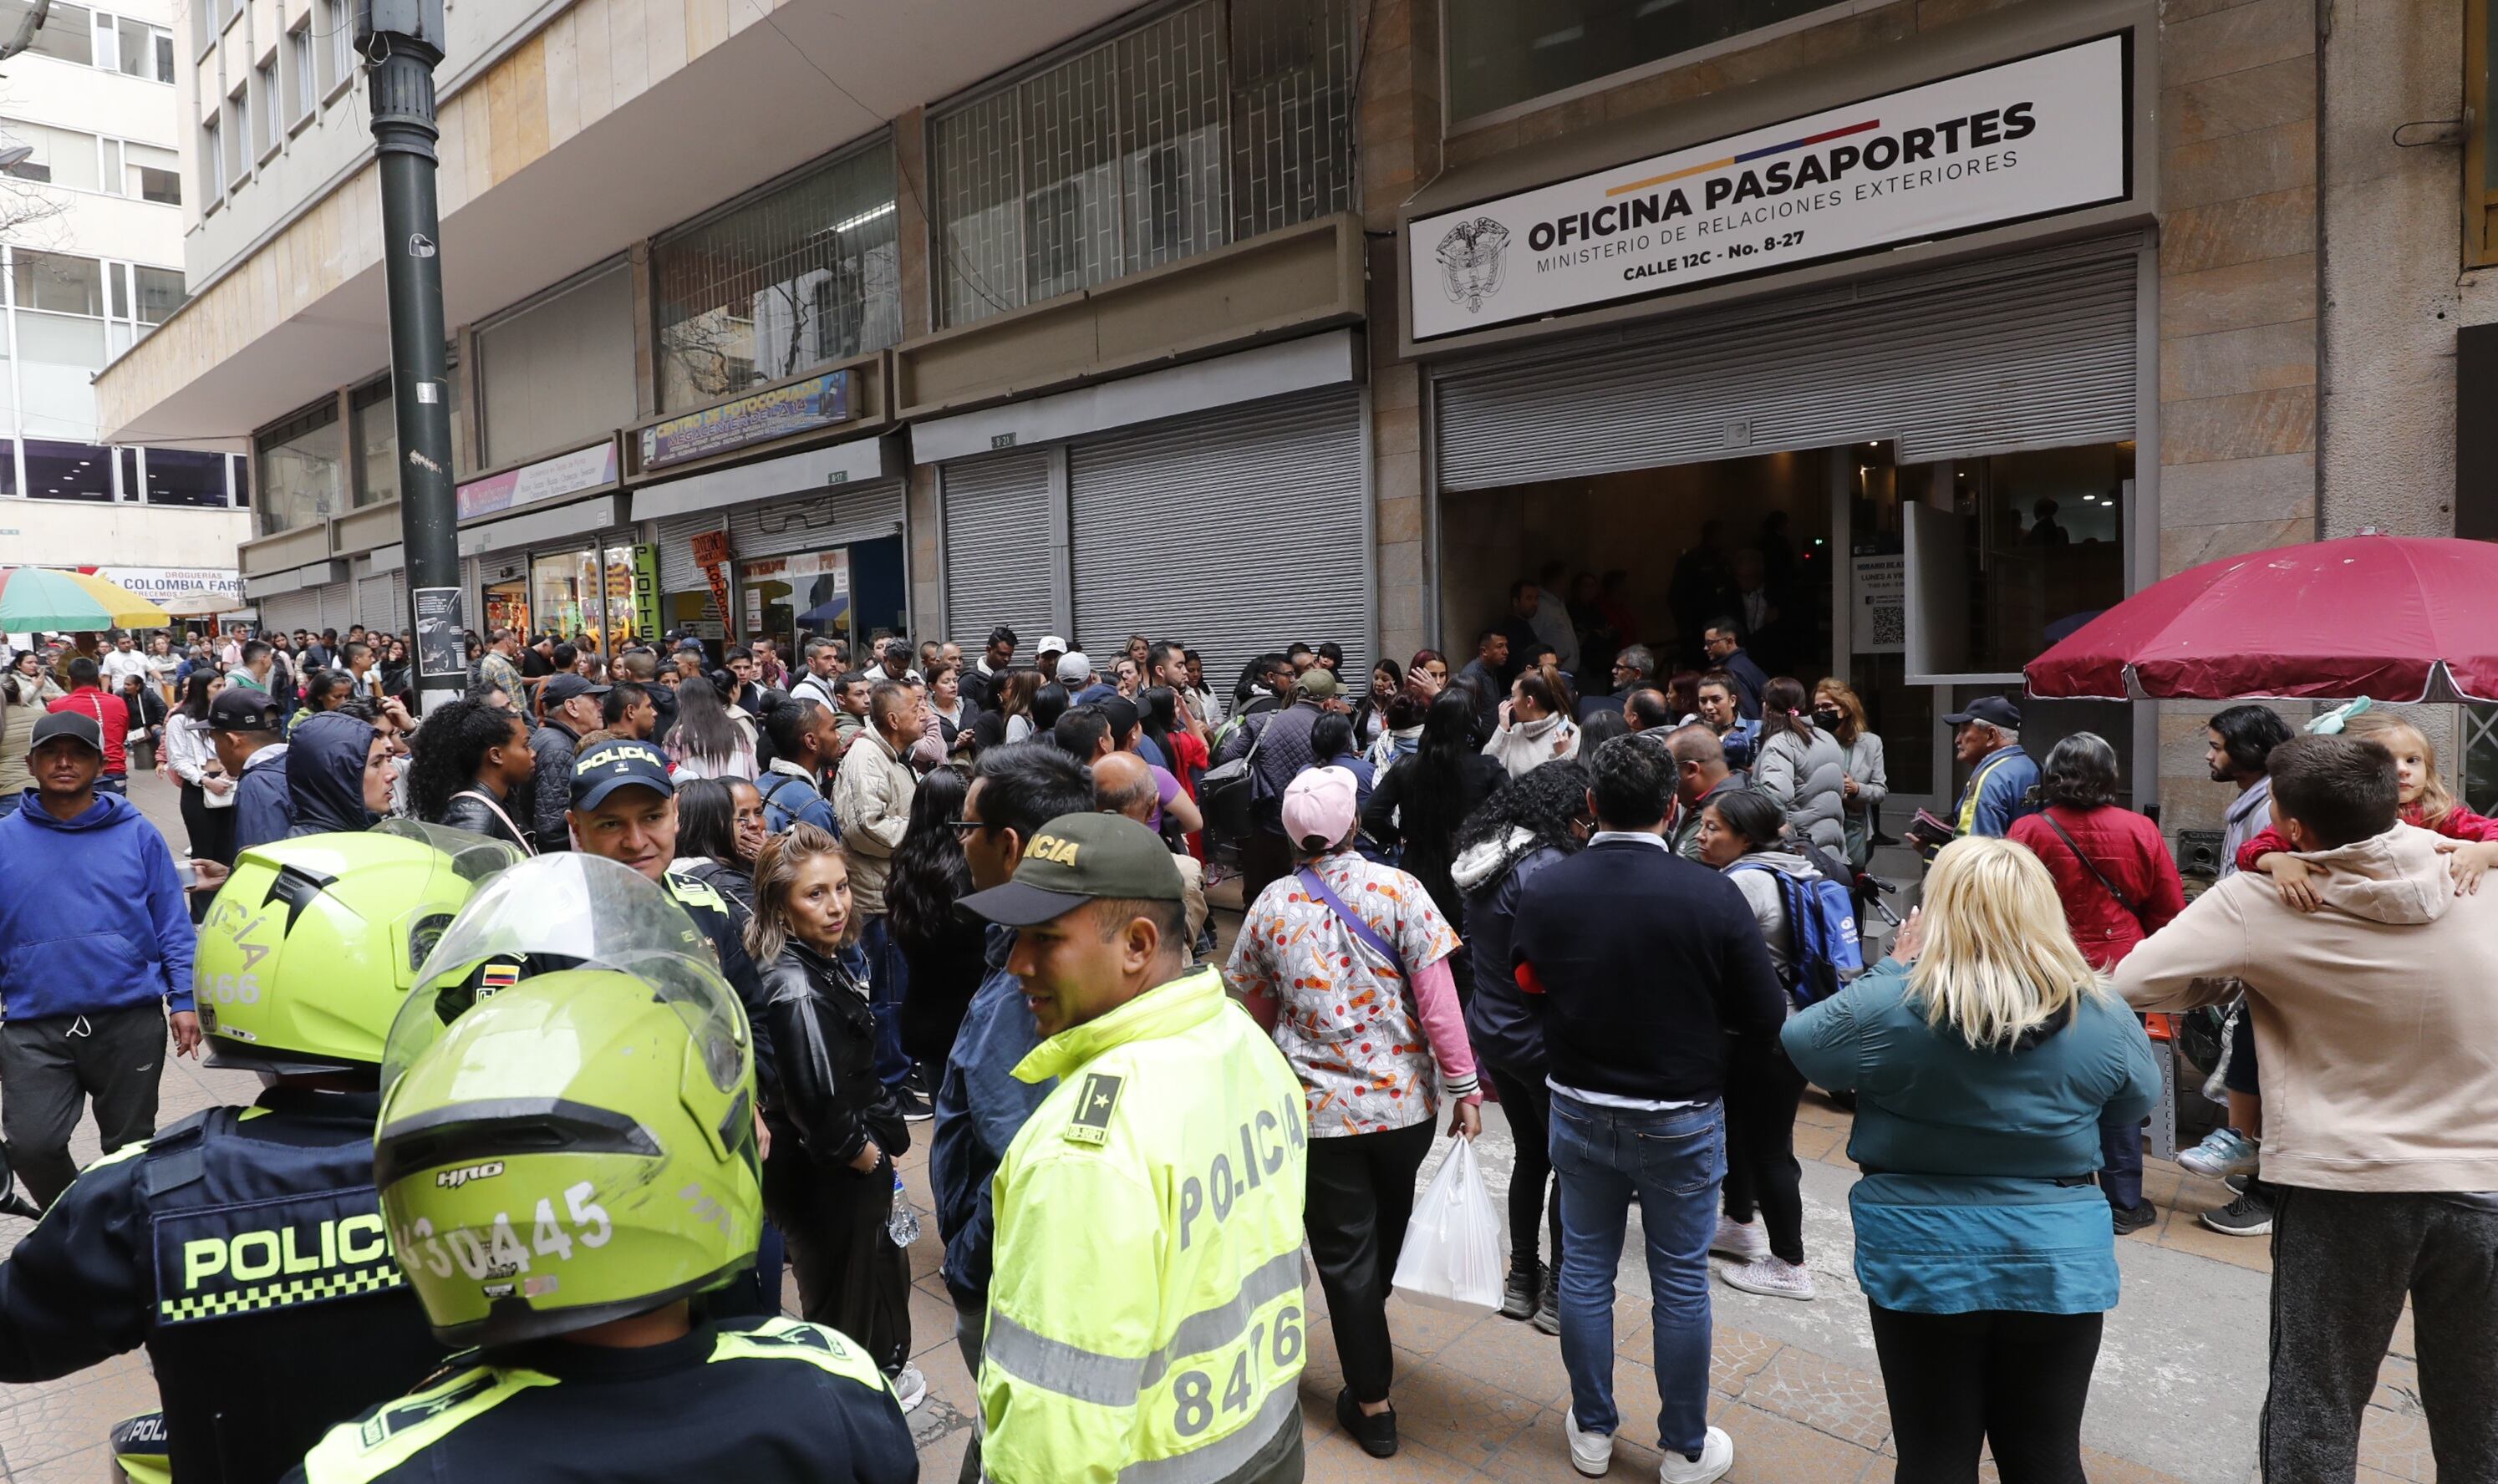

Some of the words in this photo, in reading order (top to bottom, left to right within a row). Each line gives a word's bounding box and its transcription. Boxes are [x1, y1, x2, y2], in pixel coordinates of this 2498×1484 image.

[1529, 188, 1693, 252] OFICINA
[1705, 102, 2037, 211] PASAPORTES
[1537, 235, 1650, 273] MINISTERIO
[1661, 226, 1687, 245] DE
[1698, 191, 1842, 236] RELACIONES
[1855, 150, 2017, 201] EXTERIORES
[1623, 258, 1678, 281] CALLE
[1681, 251, 1712, 268] 12C
[1728, 244, 1759, 259] No.
[1764, 231, 1805, 252] 8-27
[656, 414, 703, 438] CENTRO
[705, 408, 721, 423] DE
[723, 378, 823, 418] FOTOCOPIADO
[668, 414, 749, 447] MEGACENTER
[751, 409, 769, 422] DE
[771, 402, 790, 417] LA
[793, 399, 807, 413] 14
[125, 578, 204, 591] COLOMBIA
[634, 546, 654, 643] PLOTTE
[1022, 833, 1080, 867] ICIA
[1179, 1092, 1306, 1253] POICA
[184, 1213, 394, 1290] POLIC
